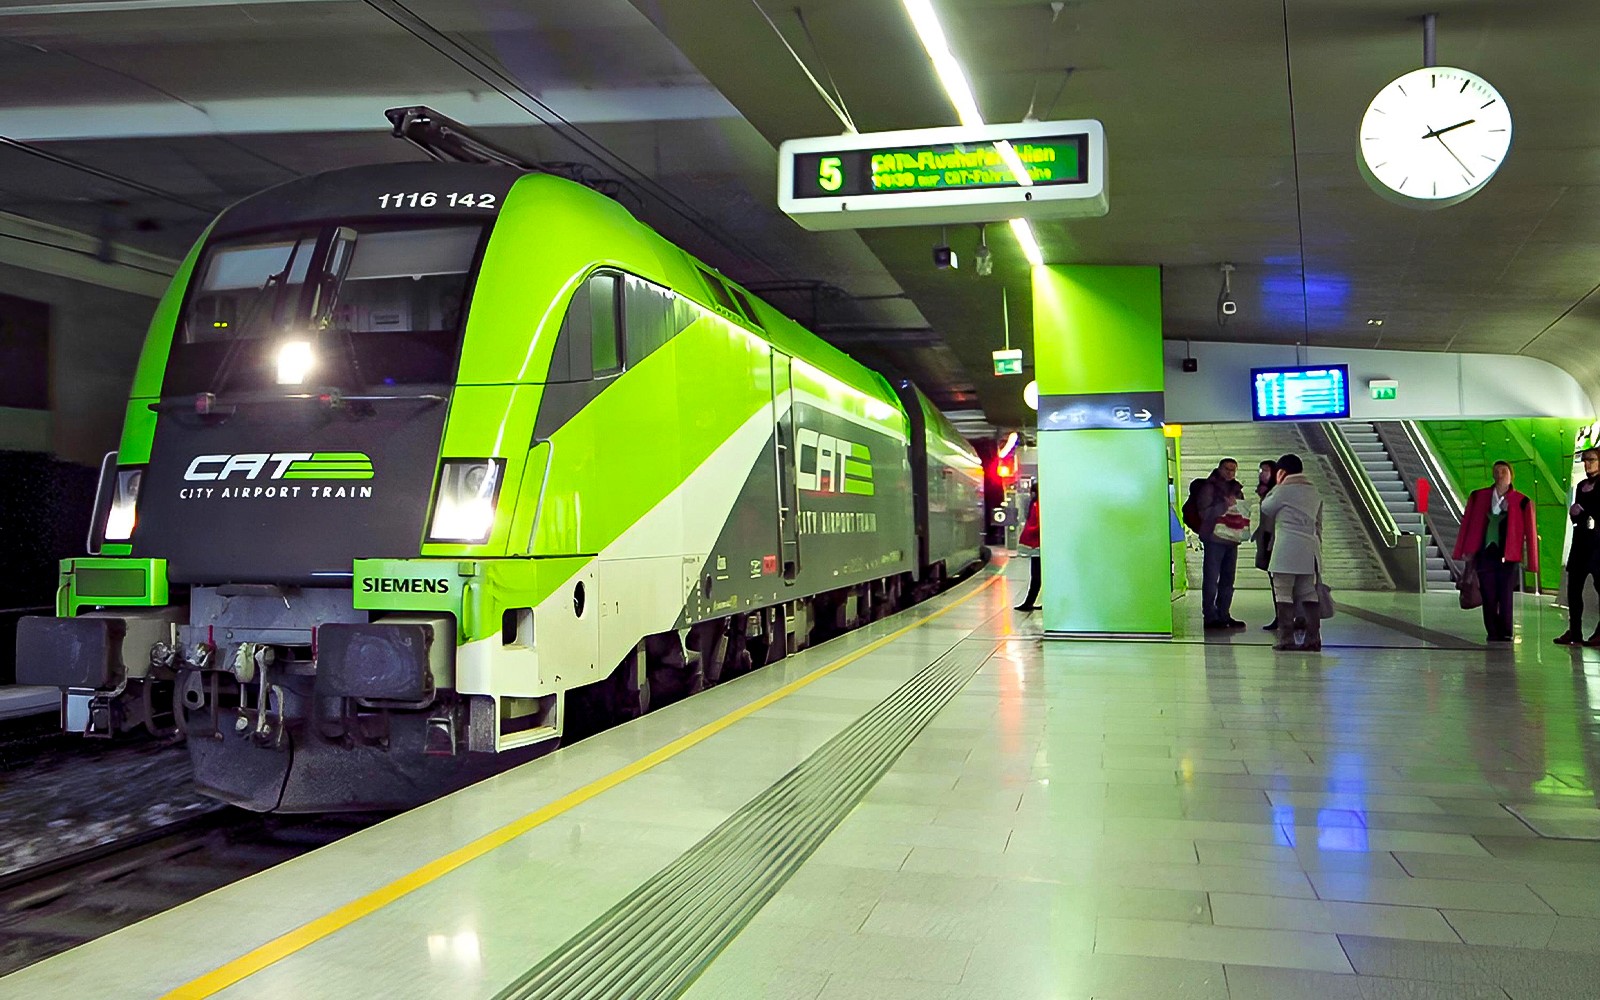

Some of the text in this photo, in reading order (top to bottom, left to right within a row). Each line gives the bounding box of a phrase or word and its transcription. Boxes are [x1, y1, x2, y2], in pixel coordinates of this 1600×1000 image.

[819, 157, 843, 191] 5
[378, 192, 496, 209] 1116 142
[183, 452, 314, 481] CAT
[796, 427, 853, 494] CAT
[179, 486, 373, 499] CITY AIRPORT TRAIN
[362, 577, 449, 594] SIEMENS
